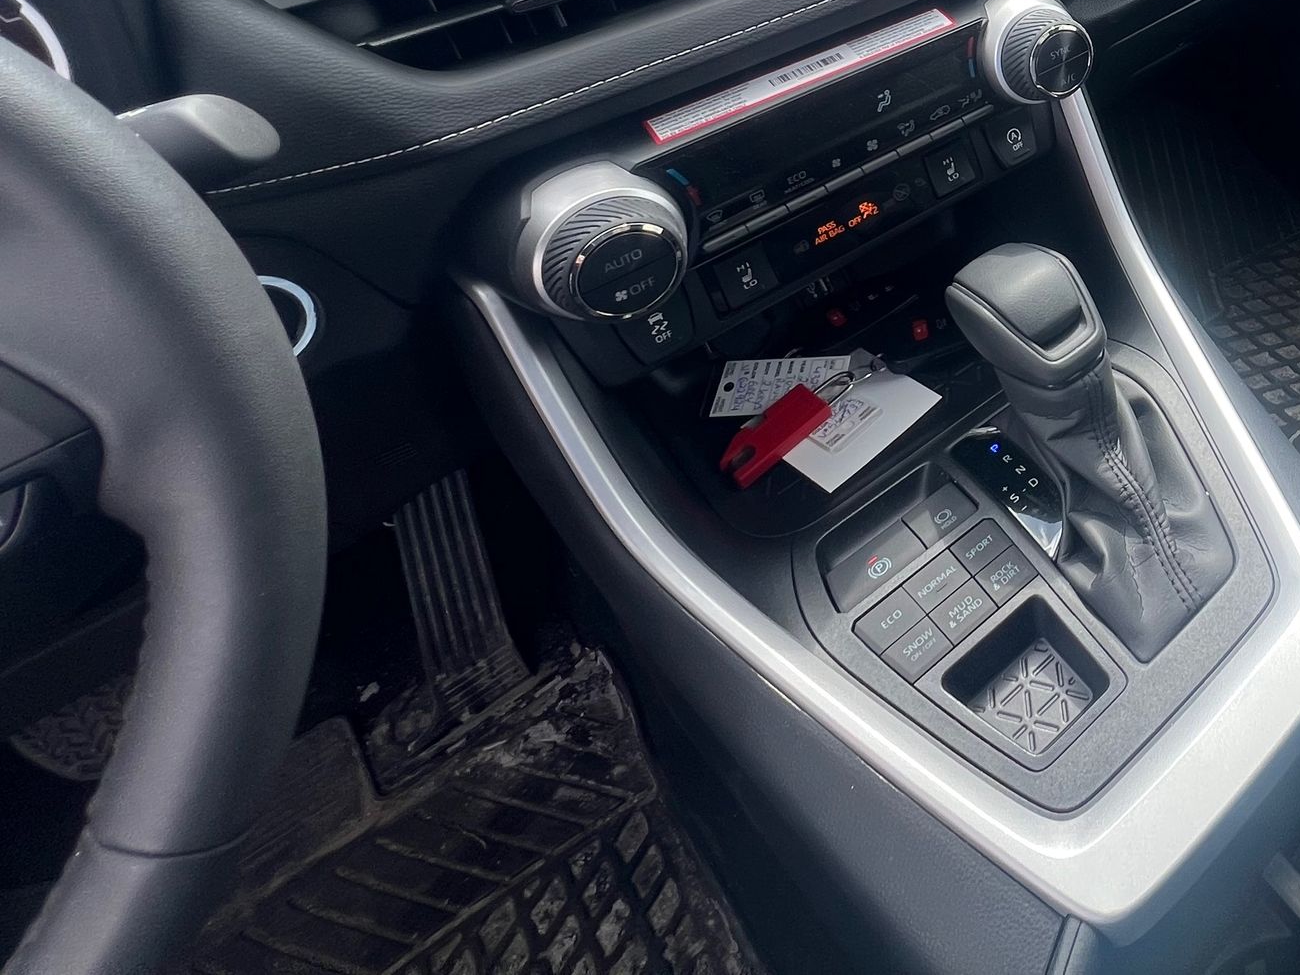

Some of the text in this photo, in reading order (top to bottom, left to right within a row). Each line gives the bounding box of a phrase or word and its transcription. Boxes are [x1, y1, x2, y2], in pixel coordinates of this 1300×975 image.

[1050, 45, 1070, 60] SYNC
[1012, 141, 1024, 151] OFF
[942, 157, 954, 165] HI
[787, 171, 807, 185] ECO
[948, 173, 960, 182] LO
[815, 215, 862, 245] AIR BAG OFF
[817, 221, 836, 235] PASS
[604, 249, 642, 273] AUTO
[736, 262, 750, 273] HI
[629, 276, 656, 295] OFF
[743, 279, 758, 290] LO
[655, 330, 673, 343] OFF
[990, 444, 1039, 487] P R N D
[1010, 493, 1020, 503] S
[941, 515, 958, 530] HOLD
[965, 534, 994, 561] SPORT
[990, 561, 1014, 583] ROCK
[993, 565, 1021, 591] & DIRT
[917, 565, 957, 599] NORMAL
[948, 595, 973, 619] MUD
[948, 598, 983, 629] & SAND
[880, 609, 902, 629] ECO
[902, 627, 934, 657] SNOW
